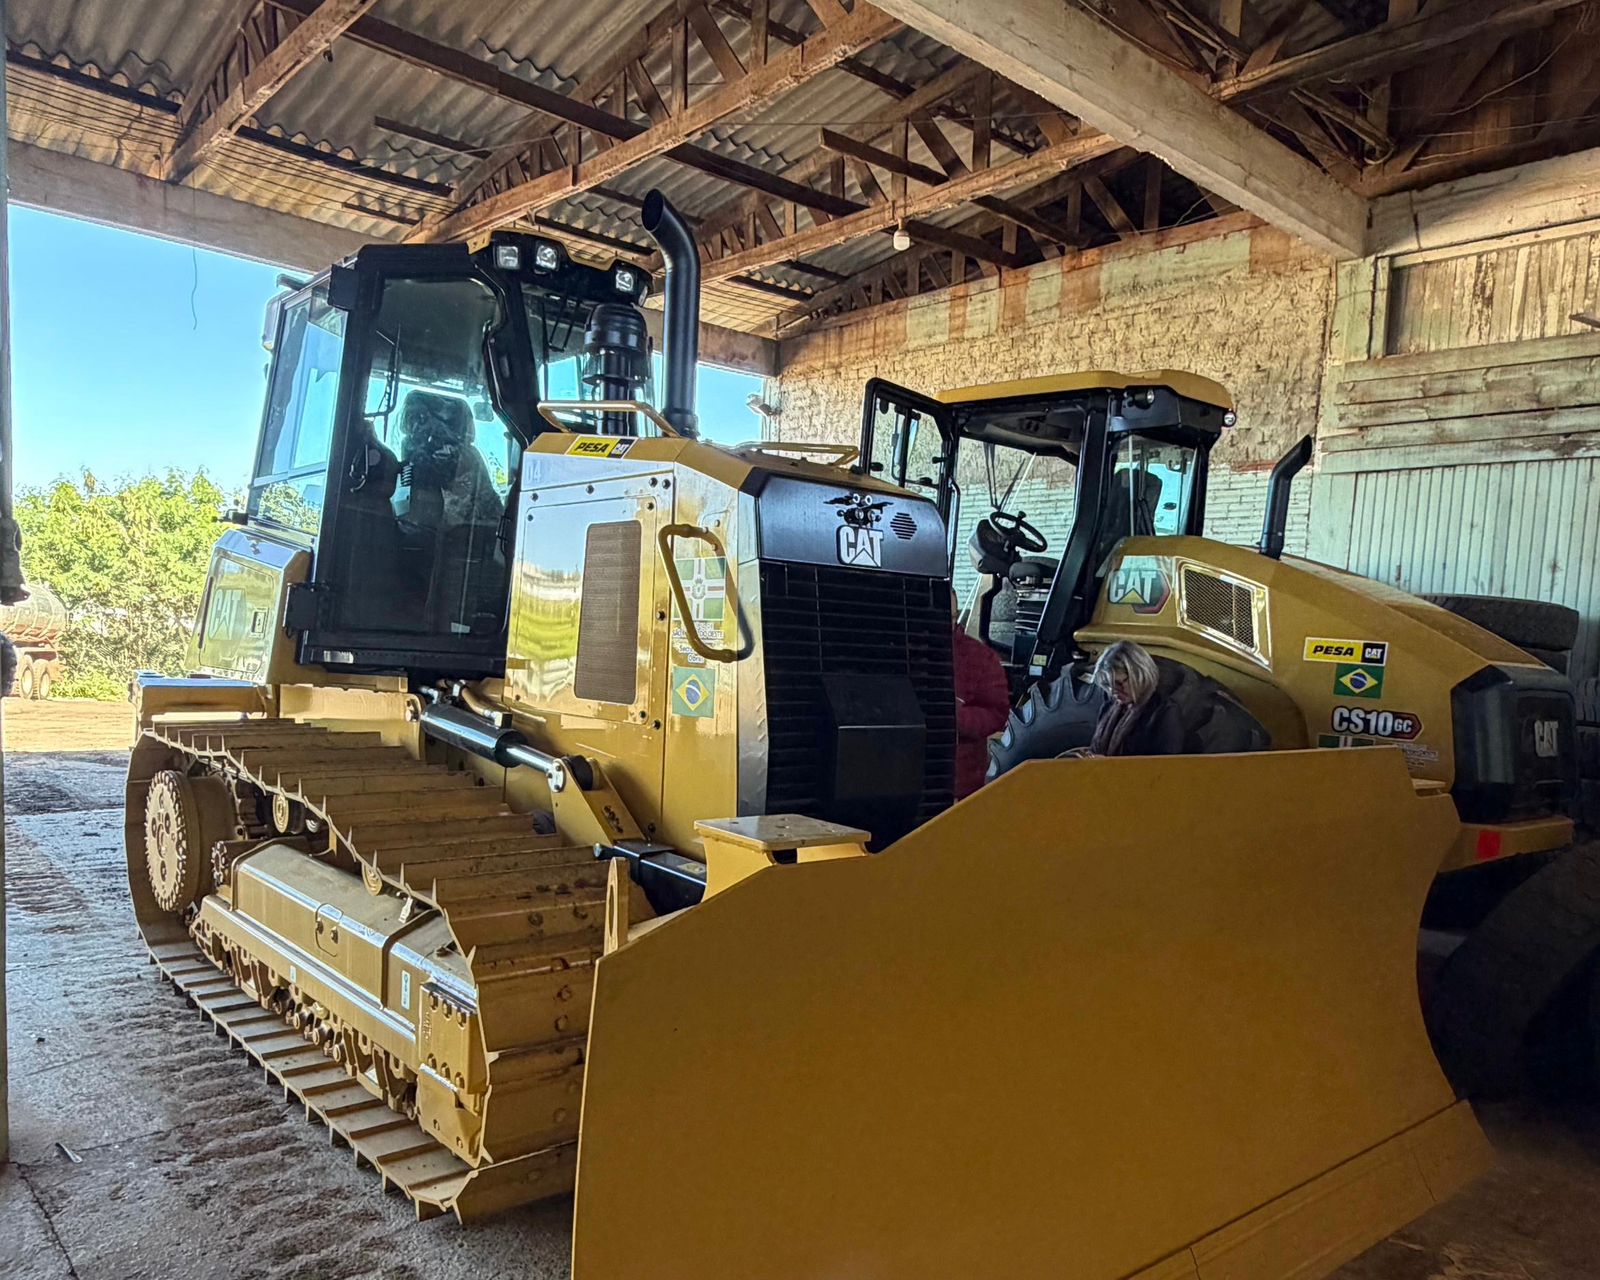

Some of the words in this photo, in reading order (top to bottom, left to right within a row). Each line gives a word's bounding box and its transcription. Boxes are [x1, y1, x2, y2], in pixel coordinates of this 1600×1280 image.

[574, 442, 610, 453] PESA
[611, 443, 630, 455] CAT
[836, 525, 884, 569] CAT
[1109, 569, 1158, 605] CAT
[208, 588, 242, 640] CAT
[1312, 645, 1355, 657] PESA
[1364, 648, 1383, 660] CAT
[1333, 707, 1394, 736] CS10
[1394, 718, 1413, 733] GC
[1534, 720, 1559, 757] CAT
